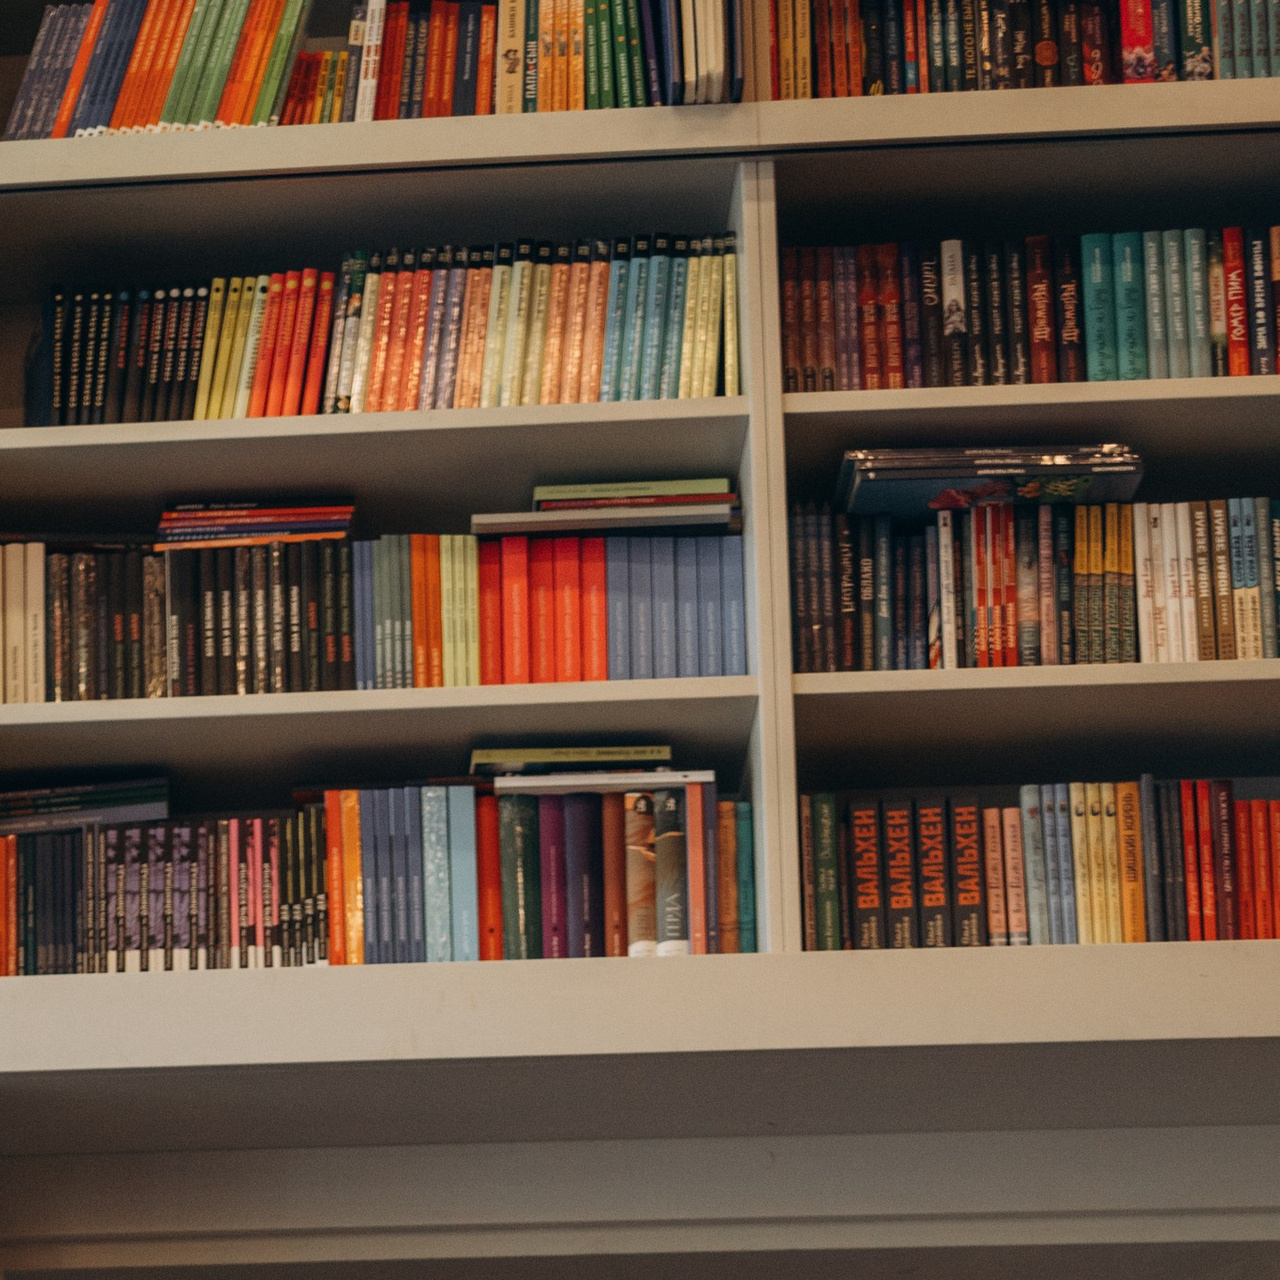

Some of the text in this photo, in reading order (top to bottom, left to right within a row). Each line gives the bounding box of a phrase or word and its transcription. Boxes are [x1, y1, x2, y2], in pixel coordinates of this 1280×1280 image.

[853, 810, 881, 909] ВАЛЬХЕН
[886, 810, 913, 909] ВАЛЬХЕН
[920, 807, 946, 907] ВАЛЬХЕН
[954, 806, 981, 905] ВАЛЬХЕН
